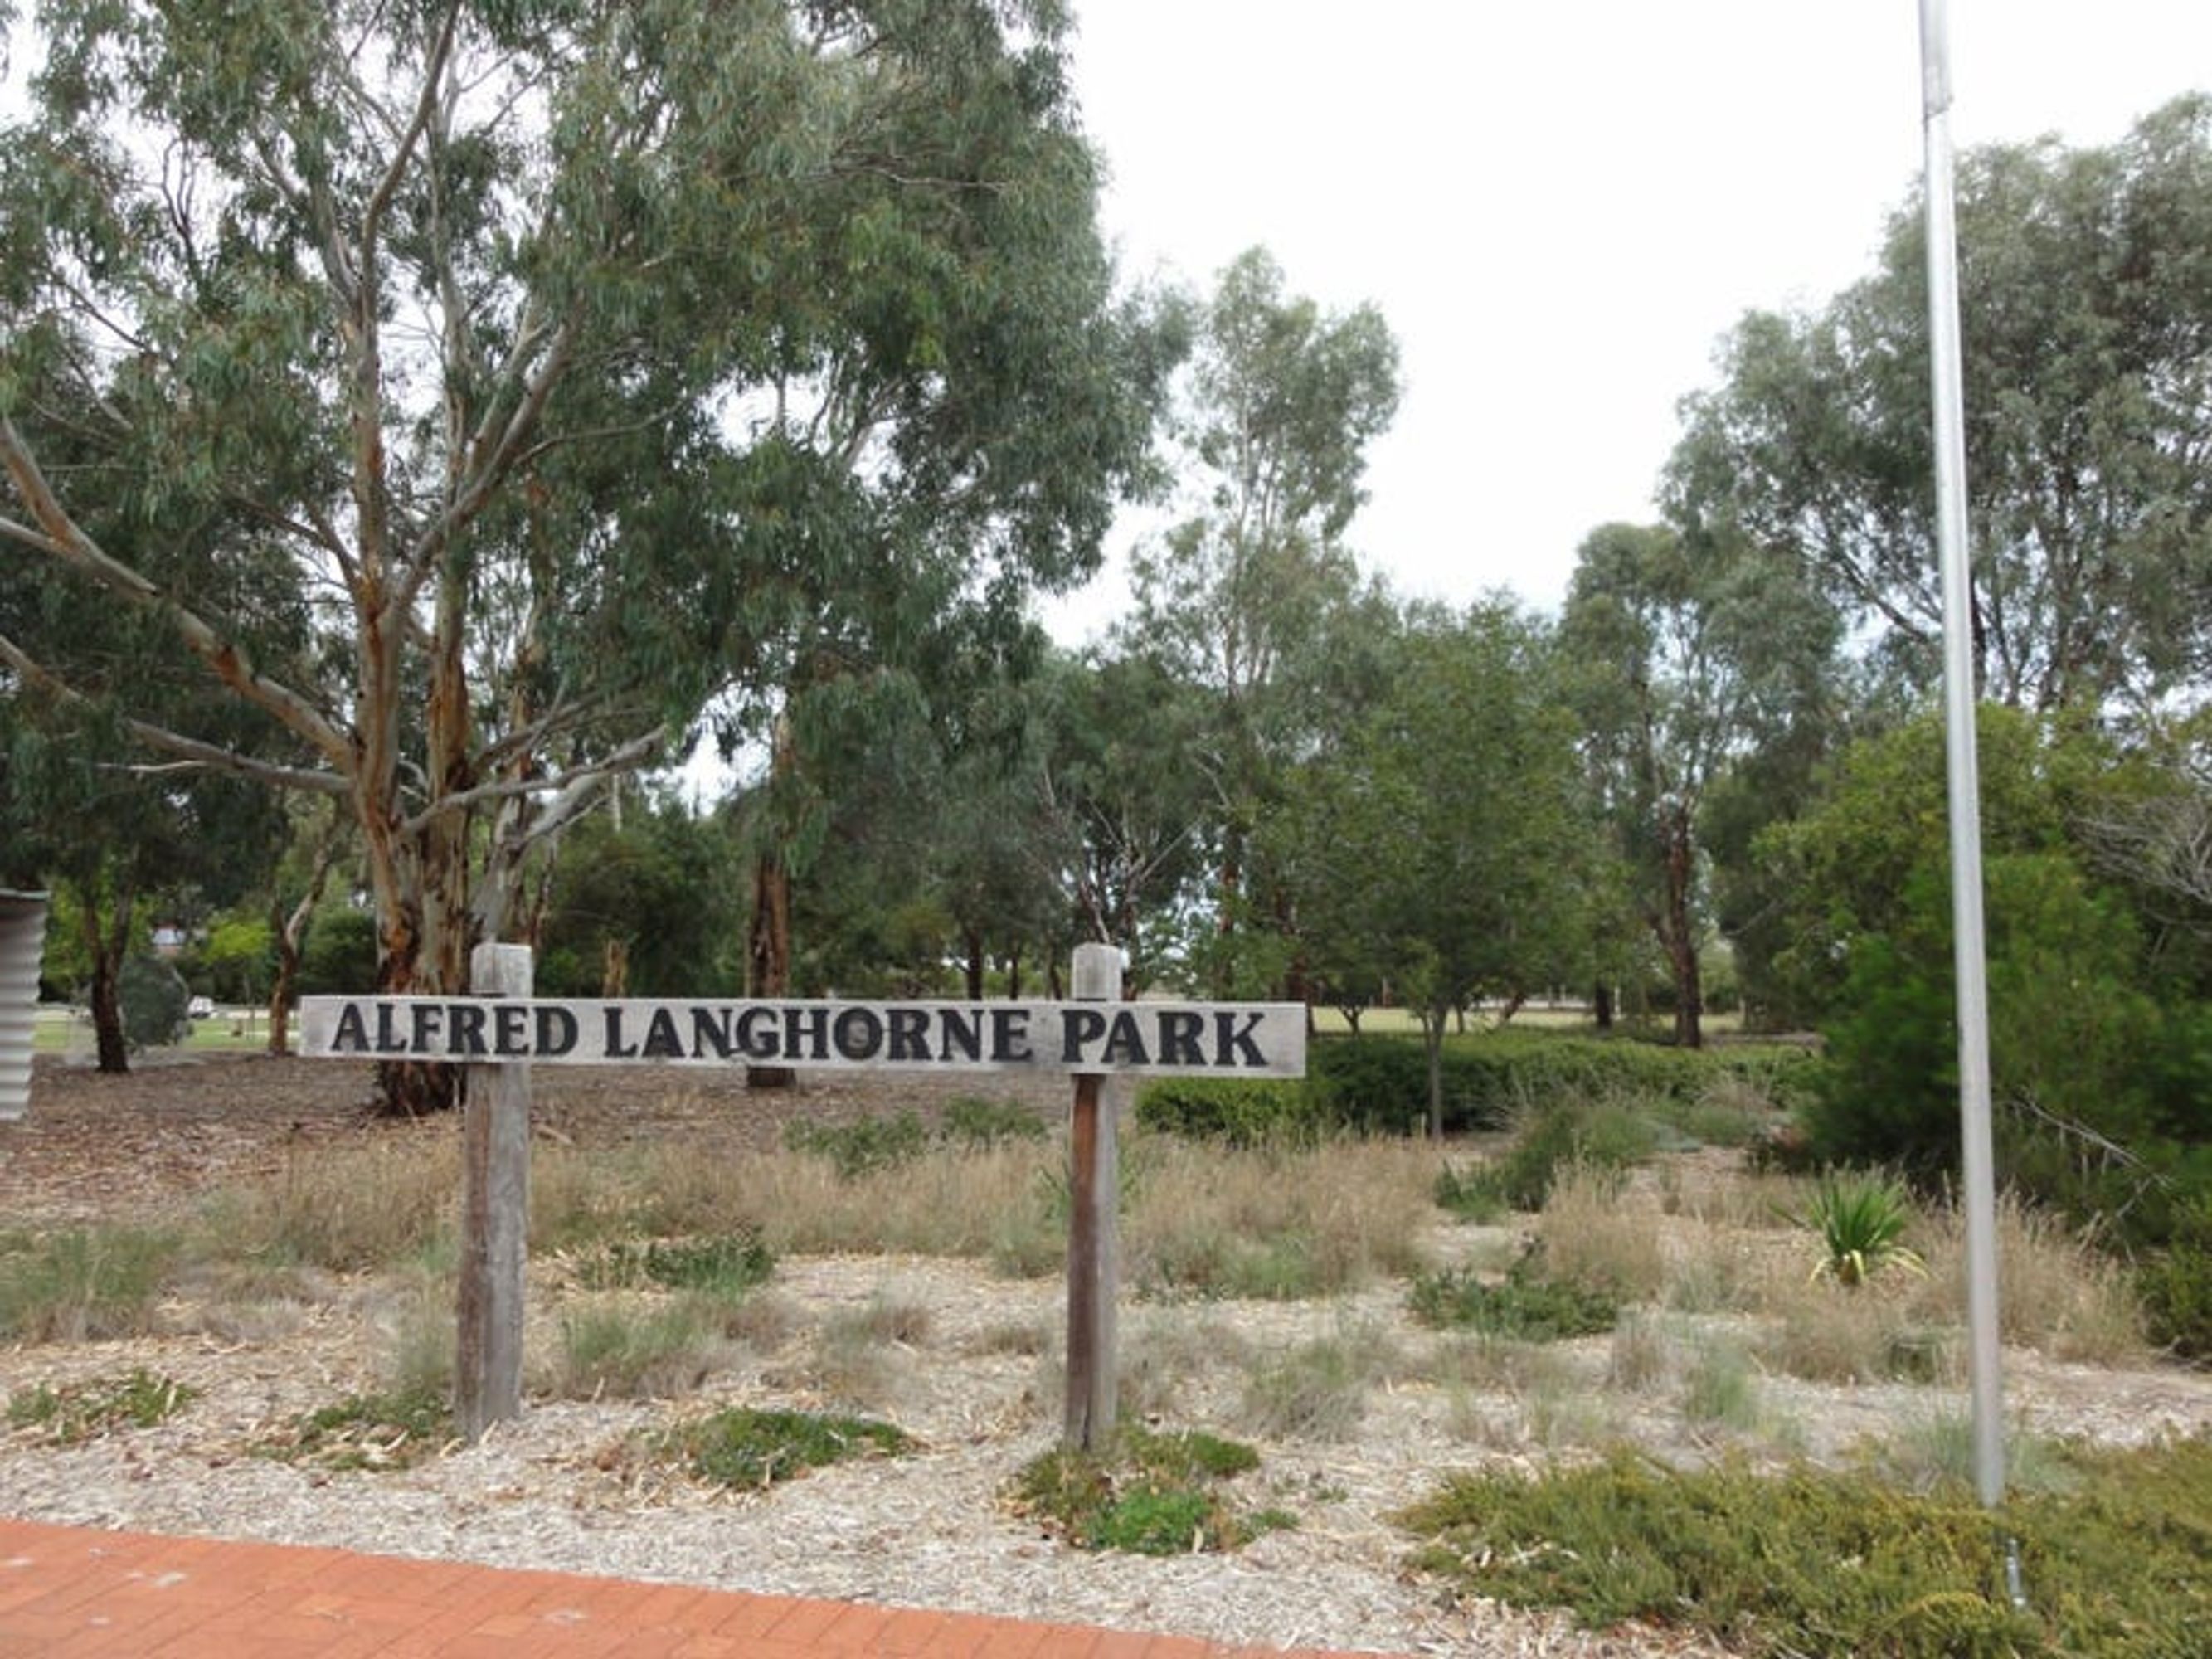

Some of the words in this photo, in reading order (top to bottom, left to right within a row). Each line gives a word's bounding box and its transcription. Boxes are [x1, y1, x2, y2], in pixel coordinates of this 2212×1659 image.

[331, 1002, 579, 1058] ALFRED
[603, 1005, 1033, 1063] LANGHORNE
[1060, 1009, 1271, 1068] PARK
